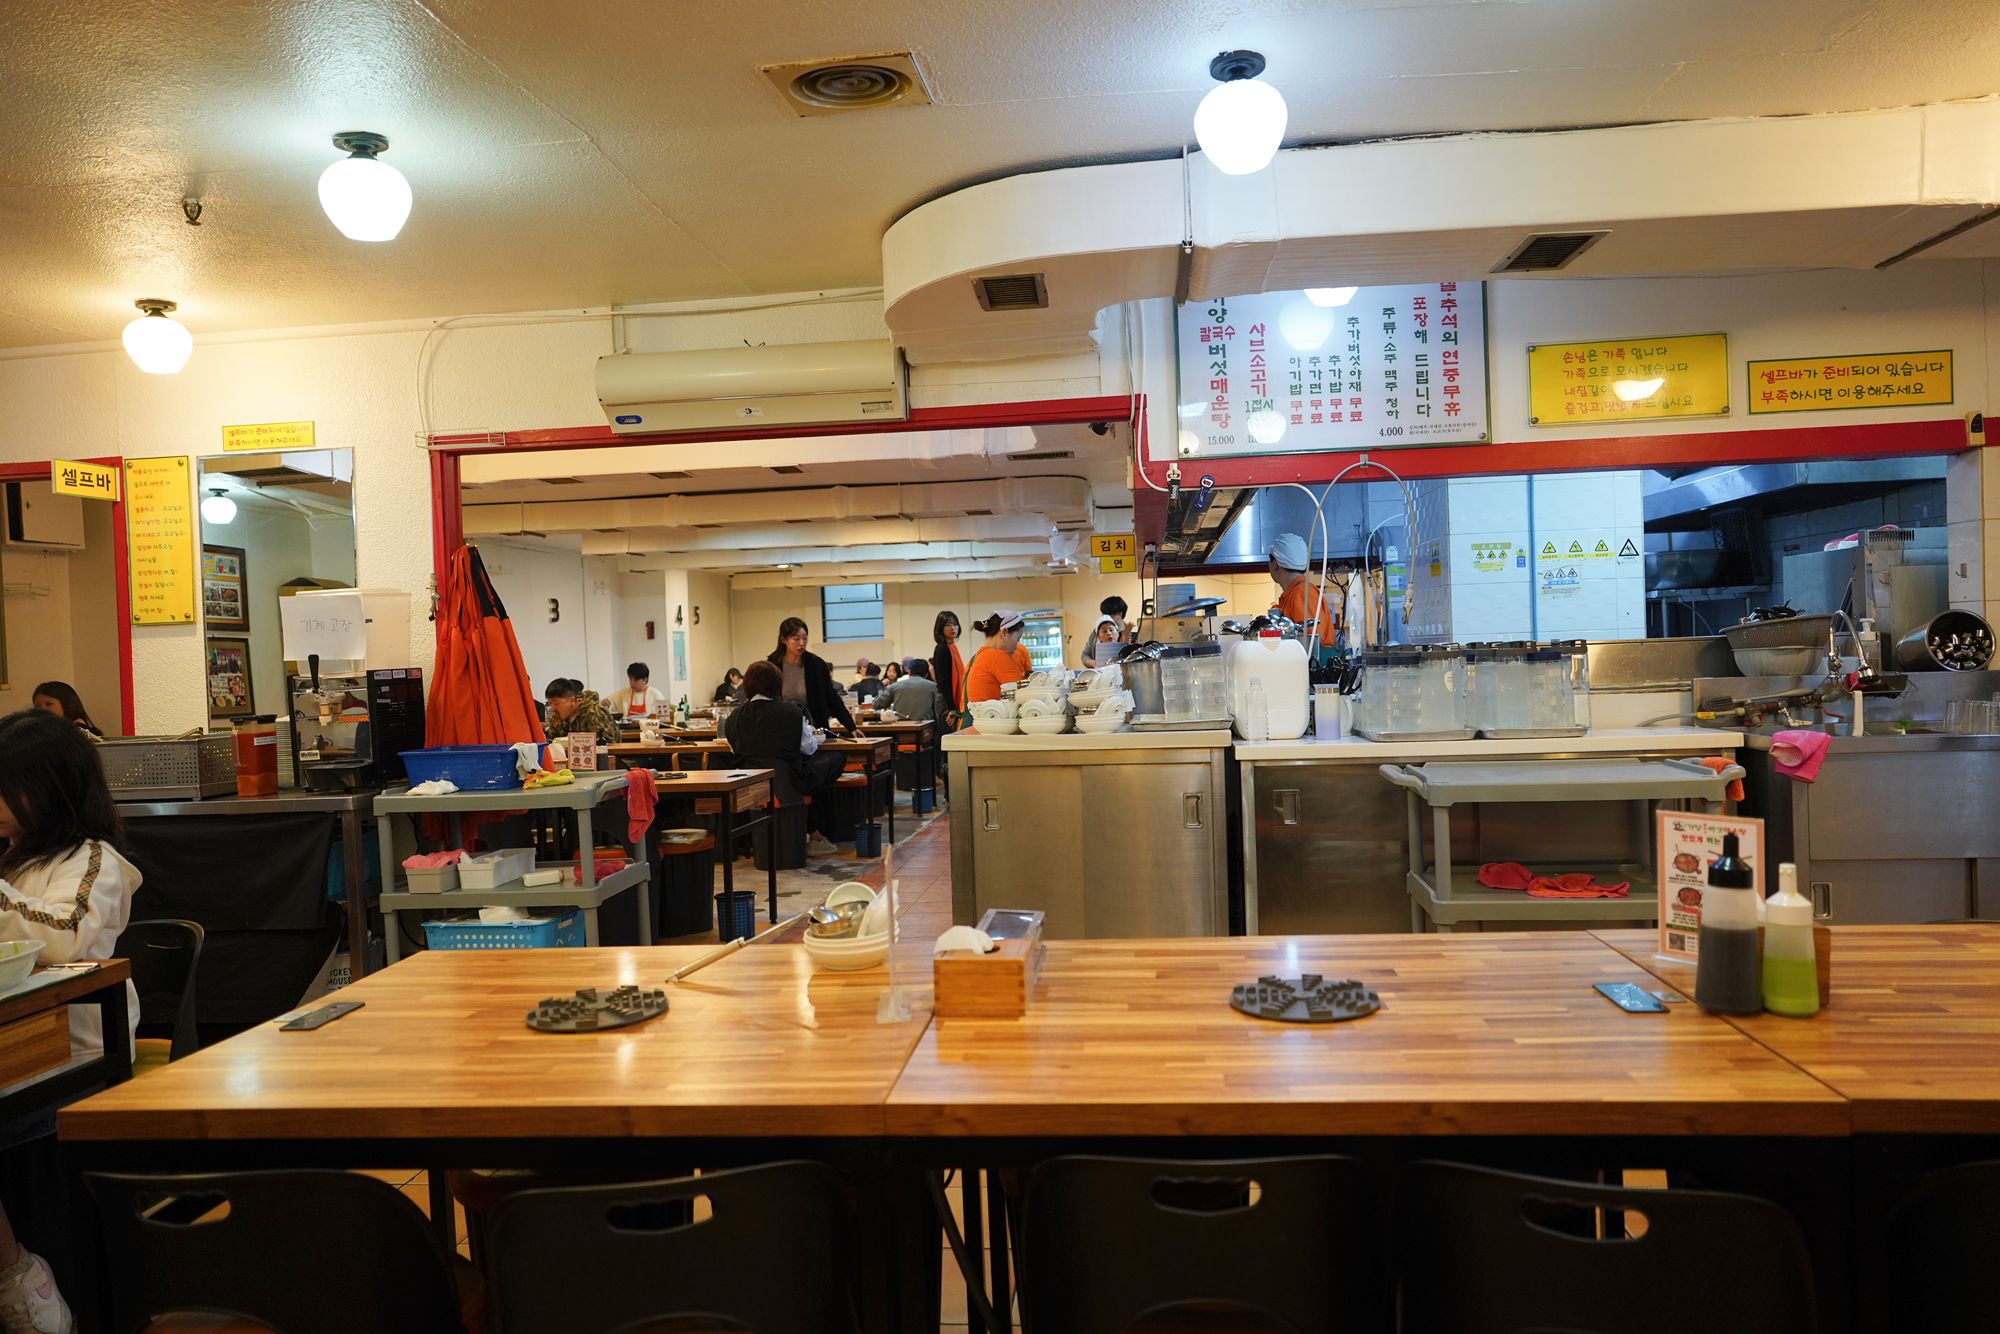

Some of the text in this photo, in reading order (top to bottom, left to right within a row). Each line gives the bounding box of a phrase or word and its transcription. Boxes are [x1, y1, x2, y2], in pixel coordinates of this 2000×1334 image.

[1199, 325, 1236, 342] 칼국수
[1413, 297, 1431, 418] 포장해 드립니다
[1562, 346, 1668, 364] 손님은 가족 입니다
[1384, 369, 1398, 392] 맥주
[1562, 362, 1689, 380] 가족으로 모시겠습니다
[1760, 361, 1945, 384] 셀프바가 준비되어 있습니다
[1289, 356, 1304, 425] 아기밥 무료
[1308, 356, 1324, 424] 추가면 무료
[1328, 354, 1343, 423] 추가밥 무료
[1442, 350, 1461, 417] 연중무휴
[1760, 382, 1926, 404] 부족하시면 이용해주세요
[1349, 397, 1363, 422] 무료
[1385, 398, 1399, 420] 청하
[1208, 435, 1235, 445] 15.000
[1379, 426, 1404, 437] 4.000
[61, 468, 111, 491] 셀프바
[1100, 539, 1126, 552] 김치
[1113, 559, 1123, 569] 면
[548, 598, 560, 623] 3
[675, 605, 683, 625] 4
[693, 606, 700, 625] 5
[1143, 598, 1155, 616] 6
